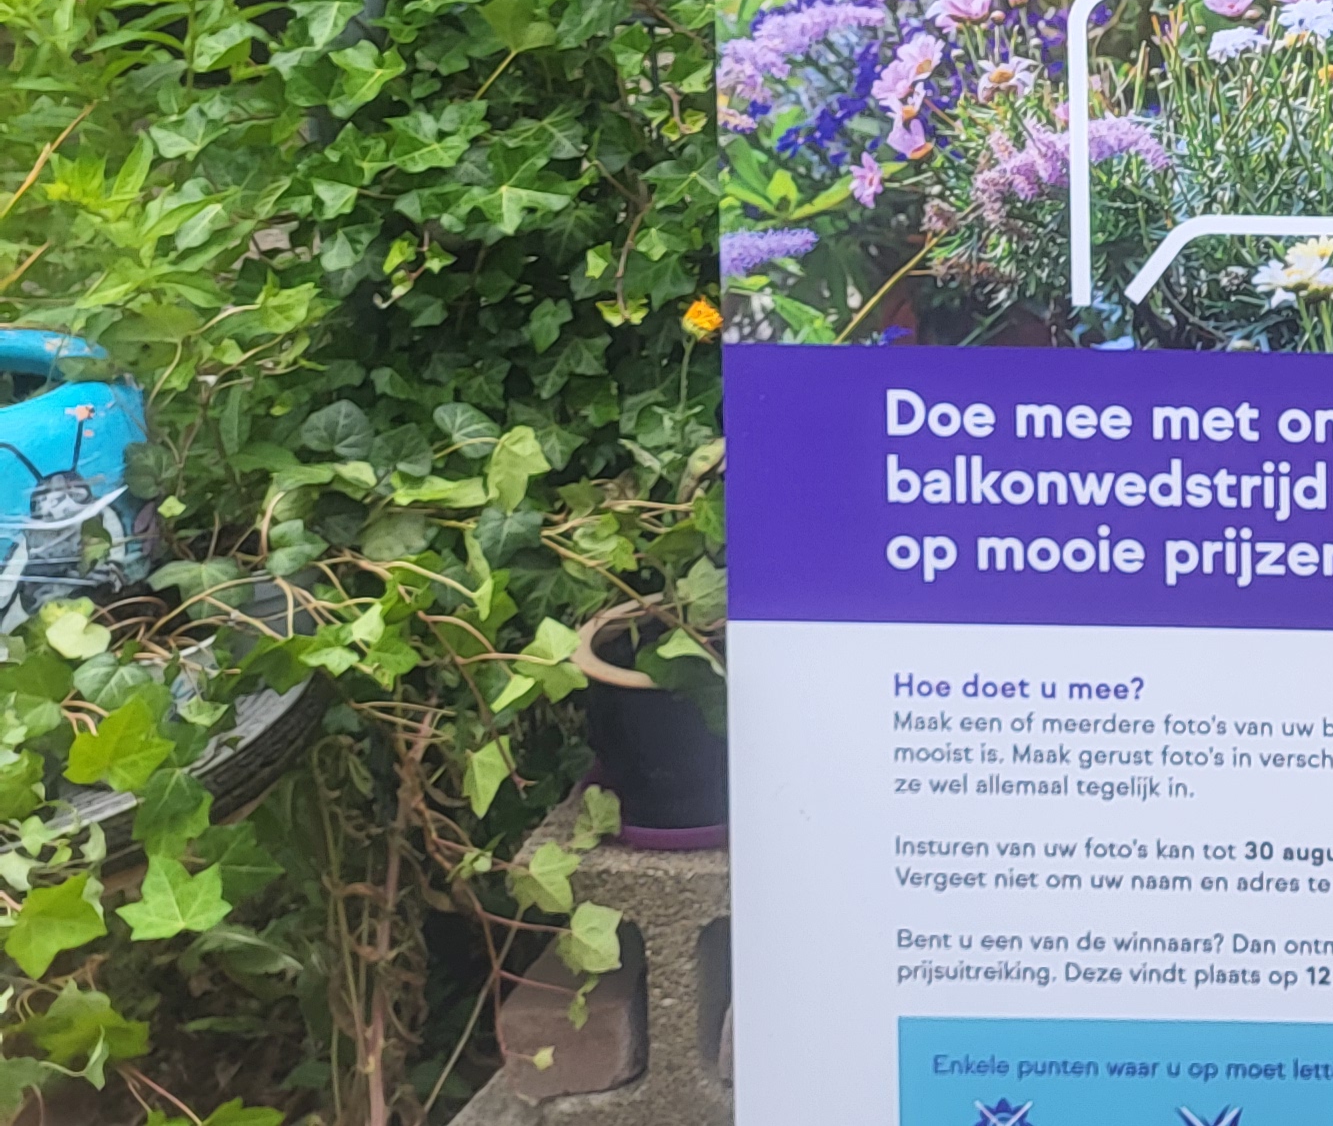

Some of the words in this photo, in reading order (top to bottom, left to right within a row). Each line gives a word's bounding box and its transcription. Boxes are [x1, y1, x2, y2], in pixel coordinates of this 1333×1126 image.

[886, 388, 996, 438] Doe
[1015, 403, 1133, 440] mee
[1152, 402, 1260, 442] met
[886, 453, 1327, 522] balkonwedstrijd
[886, 535, 958, 582] op
[977, 524, 1146, 573] mooie
[893, 672, 951, 698] Hoe
[961, 673, 1030, 699] doet
[1041, 681, 1057, 699] u
[1068, 676, 1145, 700] mee?
[893, 710, 952, 731] Maak
[959, 716, 1002, 733] een
[1010, 711, 1034, 733] of
[1042, 713, 1155, 734] meerdere
[1163, 713, 1227, 736] foto's
[1233, 721, 1273, 737] van
[1281, 722, 1314, 737] uw
[893, 742, 973, 763] mooist
[980, 742, 1004, 764] is.
[1012, 743, 1071, 764] Maak
[1078, 749, 1153, 770] gerust
[1161, 744, 1225, 766] foto's
[1232, 746, 1252, 768] in
[894, 778, 922, 793] ze
[928, 773, 968, 795] wel
[975, 773, 1069, 796] allemaal
[1076, 776, 1160, 802] tegelijk
[1168, 776, 1194, 798] in.
[895, 835, 989, 857] Insturen
[996, 842, 1036, 857] van
[1044, 843, 1077, 858] uw
[1084, 837, 1148, 859] foto's
[1156, 839, 1195, 860] kan
[1202, 844, 1236, 860] tot
[1244, 840, 1274, 861] 30
[895, 867, 987, 892] Vergeet
[994, 867, 1038, 889] niet
[1045, 874, 1082, 889] om
[1090, 874, 1124, 890] uw
[1131, 875, 1192, 891] naam
[1200, 876, 1229, 892] en
[1236, 871, 1300, 893] adres
[1307, 877, 1331, 894] te
[897, 928, 952, 950] Bent
[959, 935, 973, 950] u
[980, 934, 1023, 951] een
[1030, 935, 1069, 951] van
[1076, 931, 1106, 952] de
[1113, 931, 1225, 954] winnaars?
[1232, 933, 1276, 955] Dan
[897, 960, 1056, 987] prijsuitreiking.
[1064, 962, 1123, 983] Deze
[1129, 964, 1187, 983] vindt
[1194, 965, 1261, 989] plaats
[1268, 970, 1298, 991] op
[1305, 967, 1331, 986] 12
[933, 1054, 1010, 1077] Enkele
[1017, 1060, 1099, 1081] punten
[1106, 1061, 1160, 1078] waar
[1166, 1062, 1181, 1079] u
[1187, 1062, 1219, 1083] op
[1224, 1062, 1287, 1081] moet
